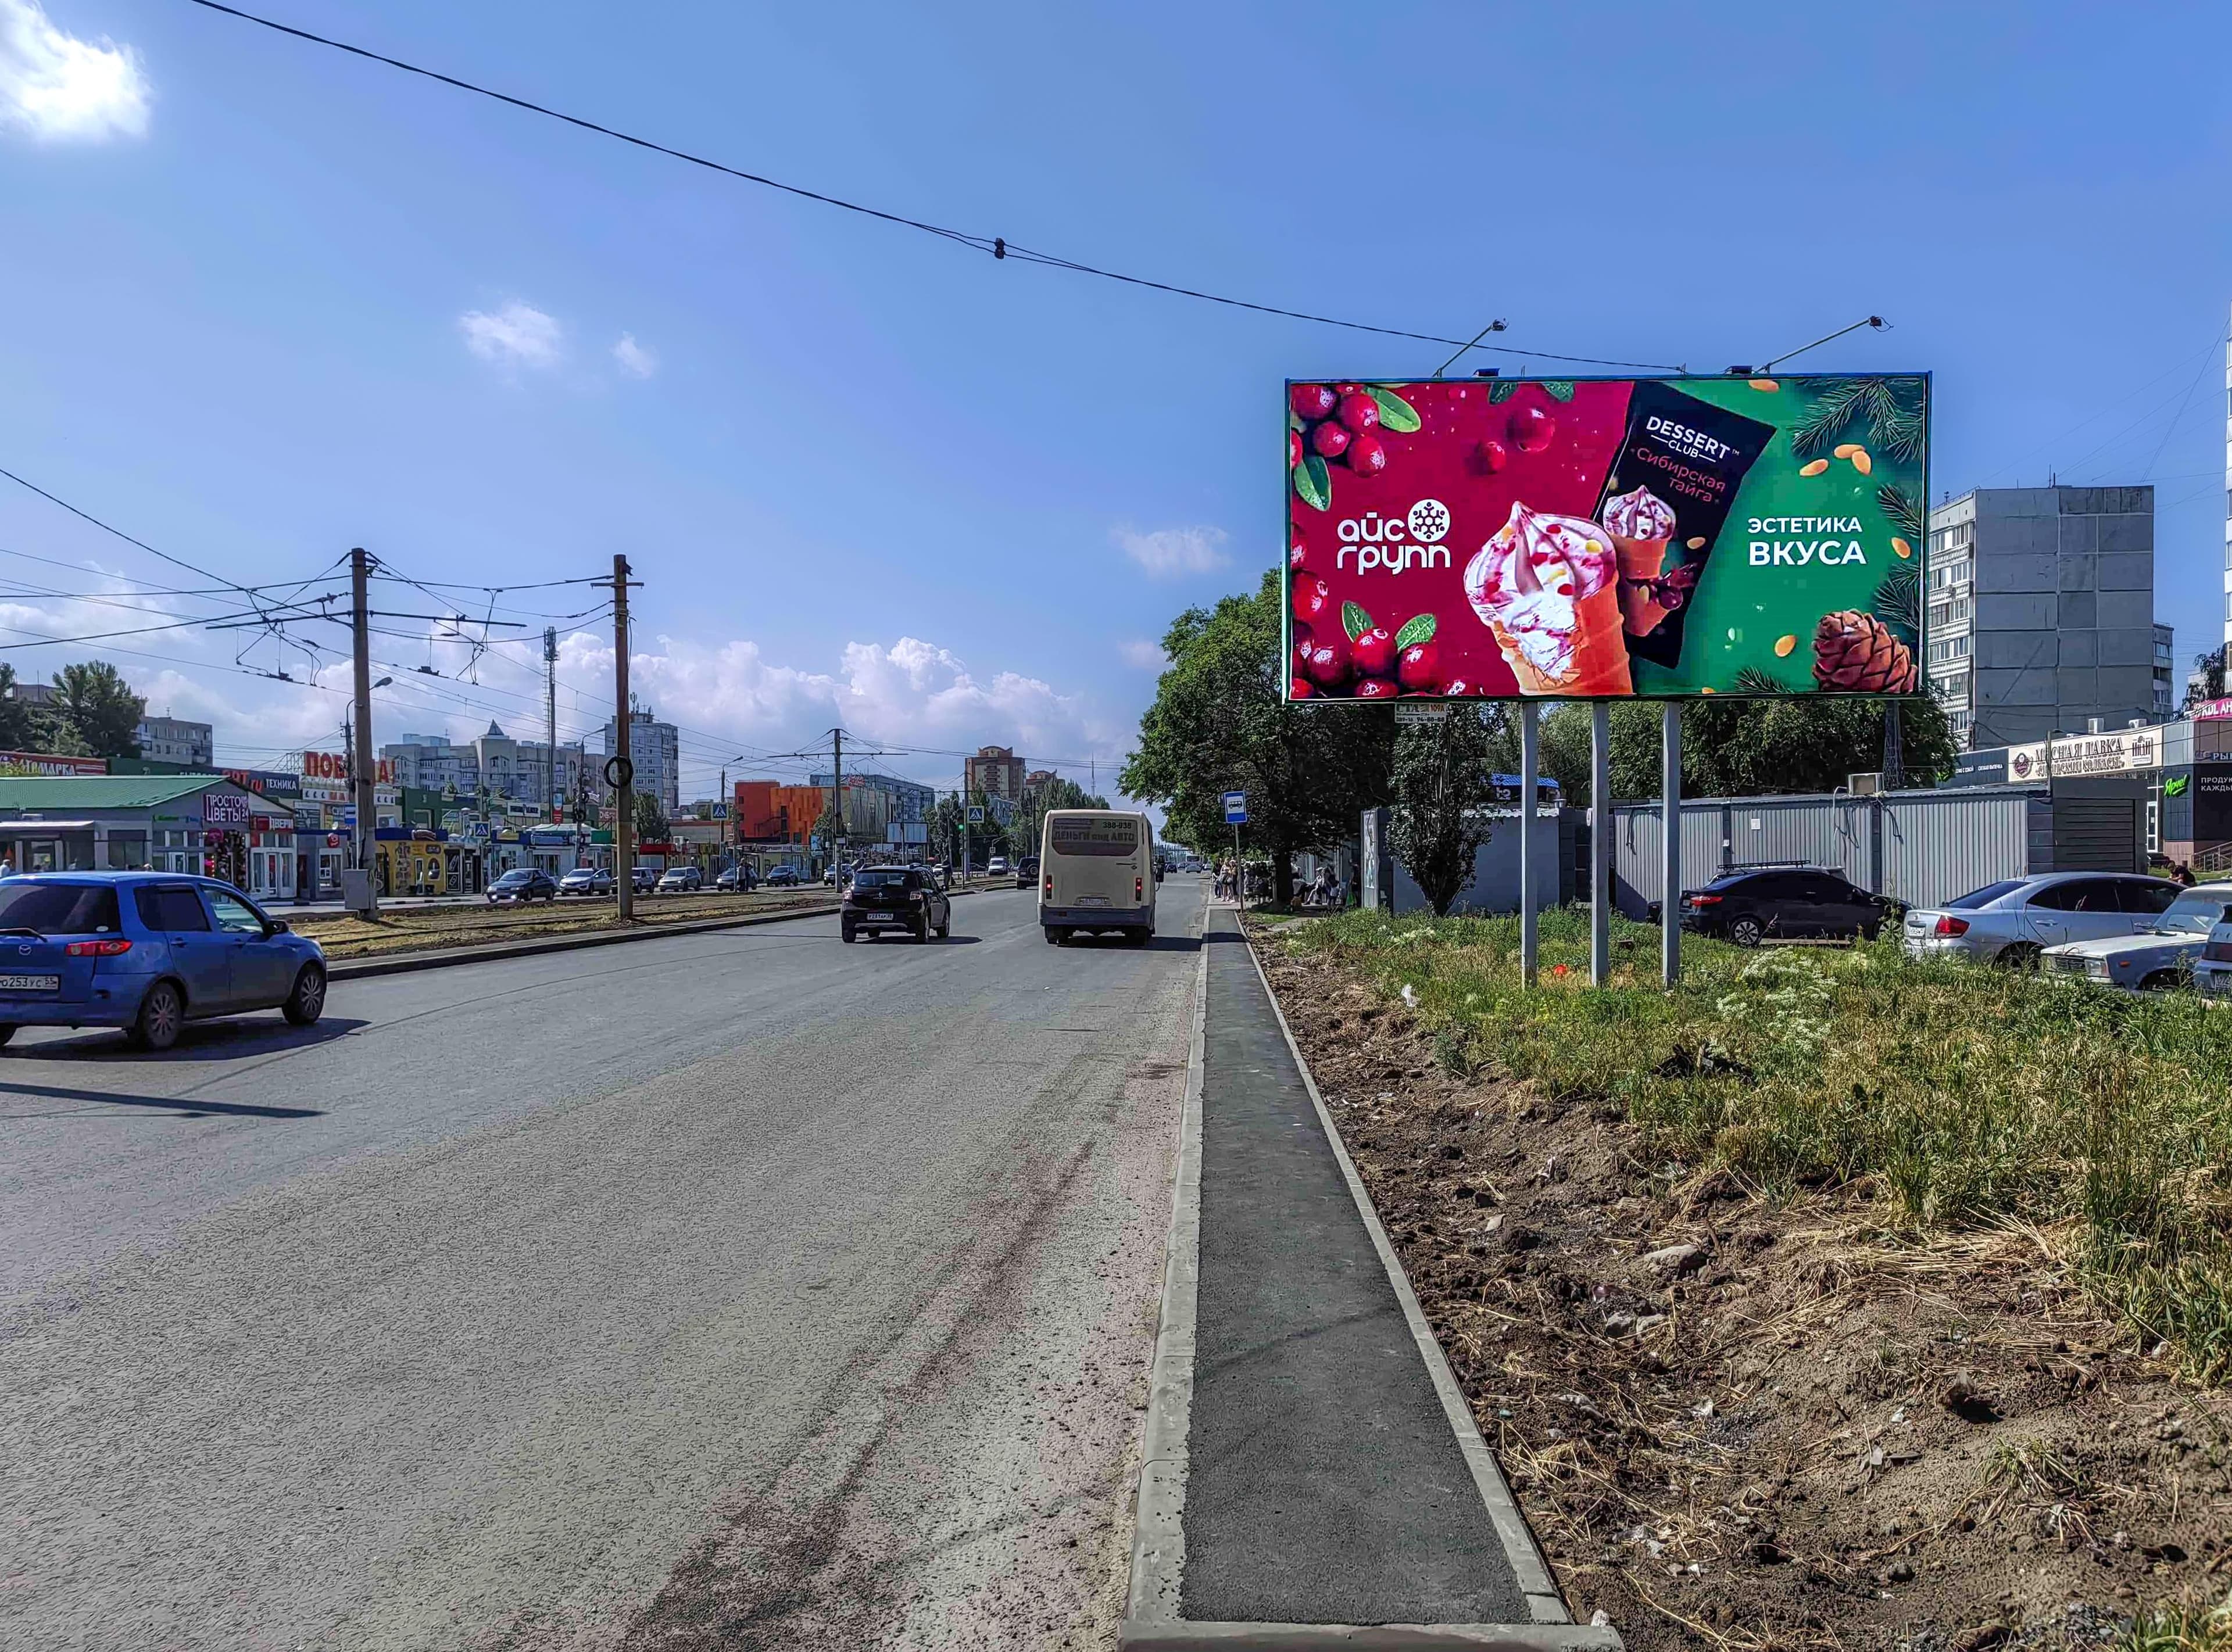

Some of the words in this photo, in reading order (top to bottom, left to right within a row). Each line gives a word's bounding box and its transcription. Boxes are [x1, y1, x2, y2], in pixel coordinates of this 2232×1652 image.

[1646, 416, 1730, 458] DESSERT
[1668, 440, 1699, 458] CLUB
[1637, 447, 1725, 492] Сибирская
[1669, 477, 1712, 502] тайга
[1747, 517, 1862, 533] ЭСТЕТИКА
[1337, 545, 1450, 575] групп
[1749, 540, 1867, 565] ВКУСА
[2036, 743, 2080, 762] МСНАЯ
[2085, 737, 2123, 757] ЛАВКА
[266, 778, 297, 791] ТЕХНИКА
[2165, 774, 2187, 795] Ярче!
[206, 794, 241, 808] ПРОСТО
[206, 807, 241, 823] ЦВЕТЫ
[1054, 830, 1090, 841] ДЕНЬГИ
[1111, 832, 1135, 841] АВТО
